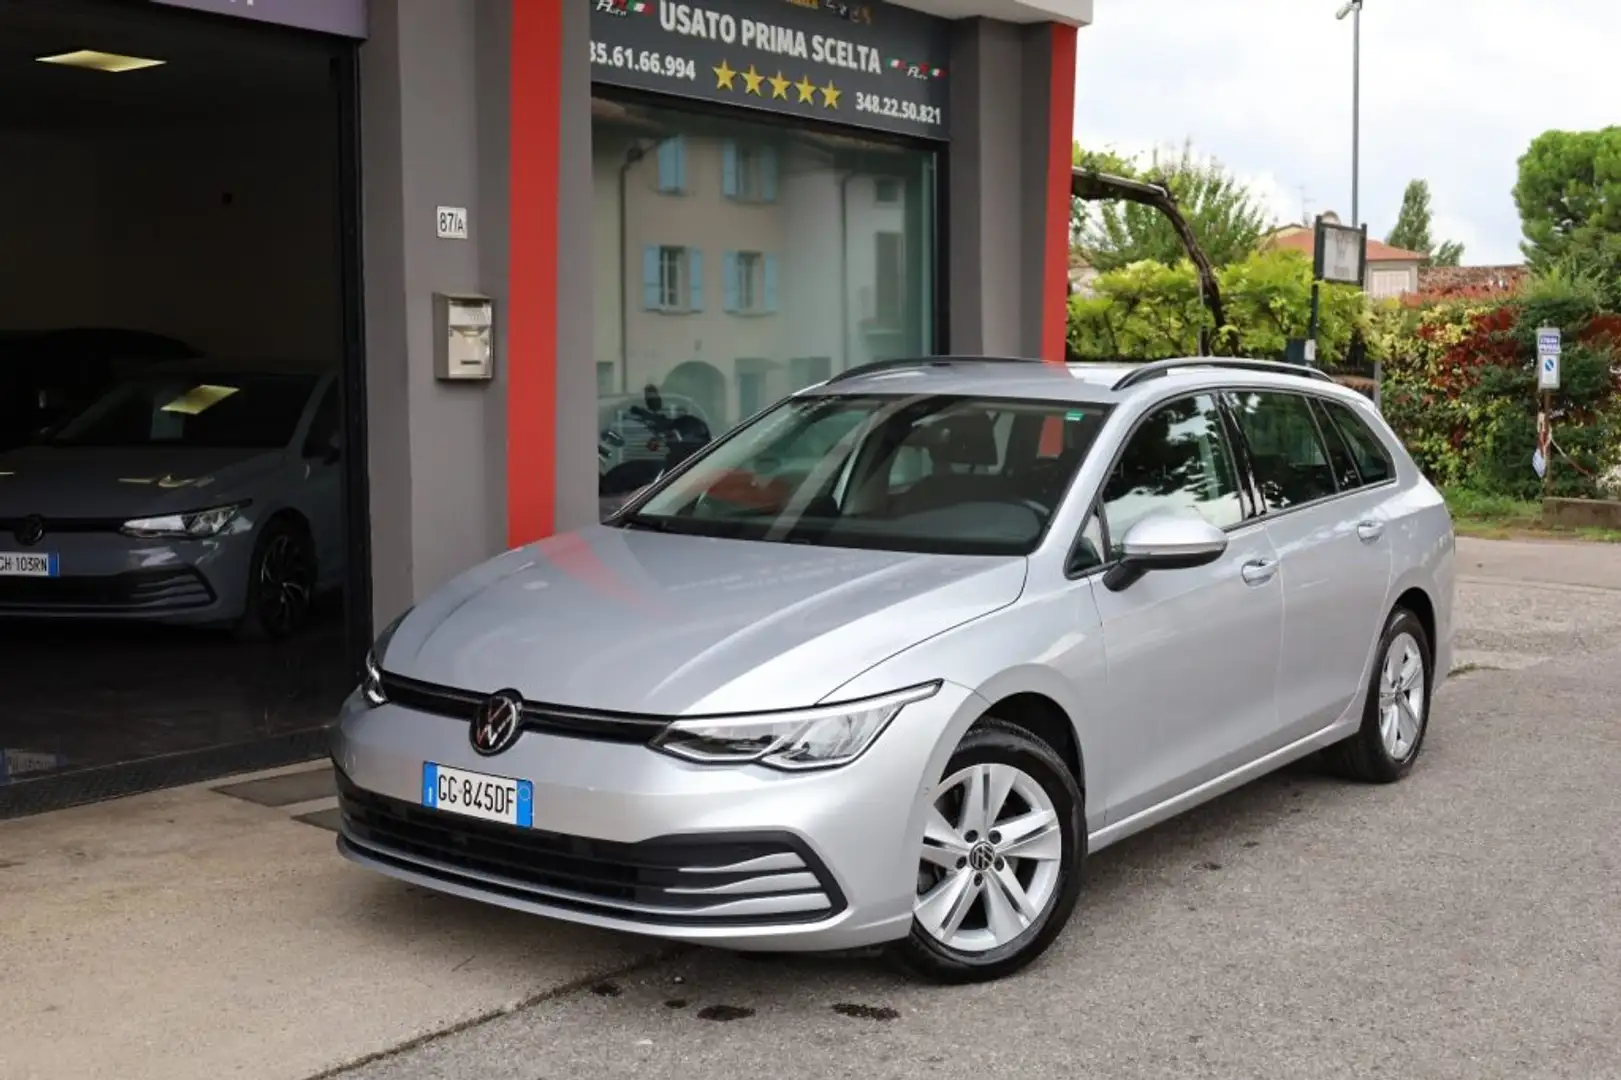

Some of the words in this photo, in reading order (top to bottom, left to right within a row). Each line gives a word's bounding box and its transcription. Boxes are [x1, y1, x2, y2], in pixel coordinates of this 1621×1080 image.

[660, 1, 736, 44] USATO
[741, 18, 809, 61] PRIMA
[811, 34, 882, 75] SCELTA
[855, 91, 942, 125] 348.22.50.821
